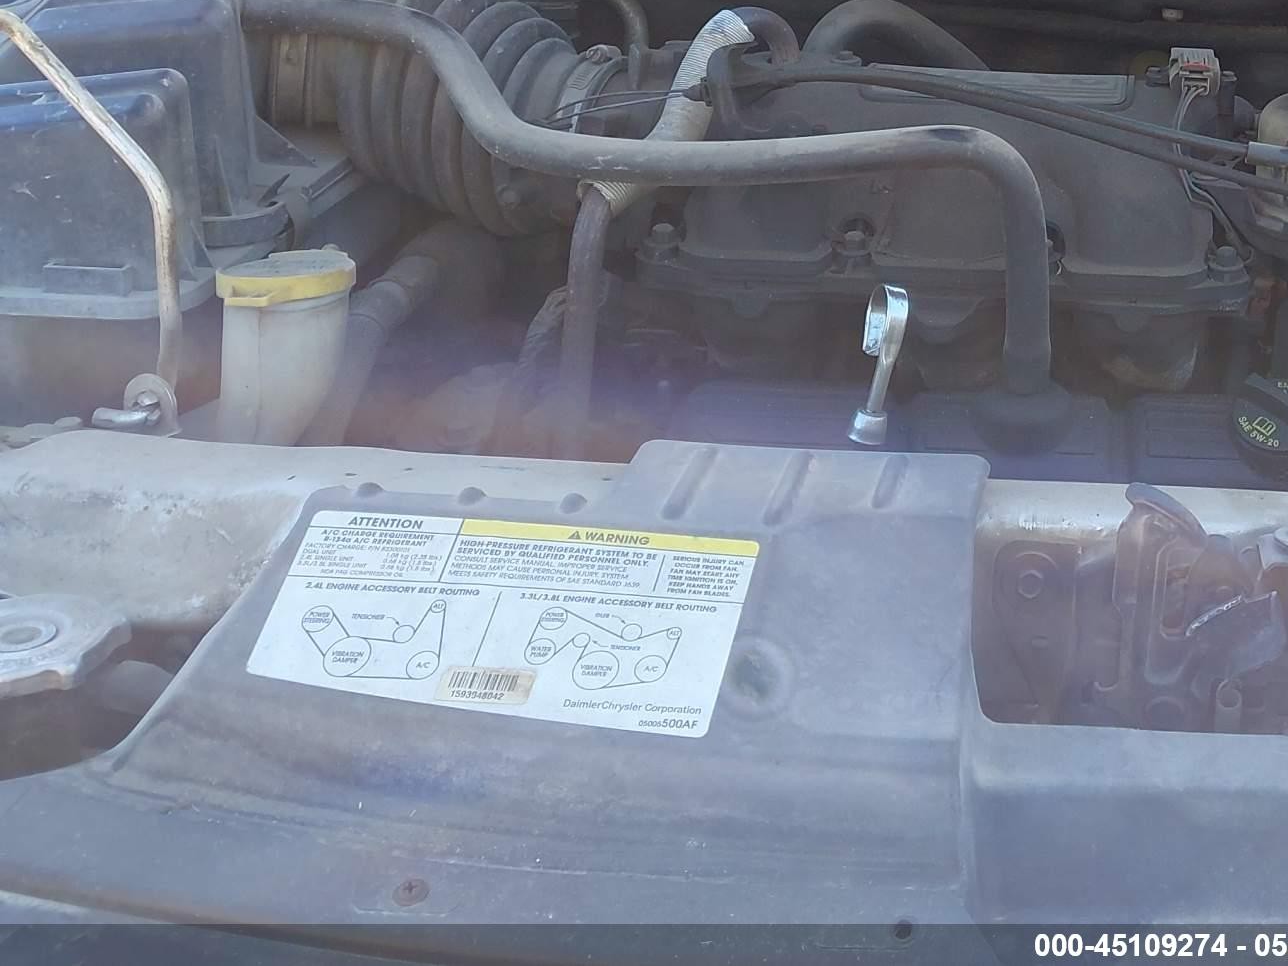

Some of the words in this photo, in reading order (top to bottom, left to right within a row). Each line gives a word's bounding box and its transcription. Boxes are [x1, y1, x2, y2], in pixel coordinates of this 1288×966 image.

[1238, 416, 1253, 433] SAE
[348, 516, 423, 530] ATTENTION
[342, 530, 378, 538] CHARGE
[379, 531, 435, 541] REQUIREMENT
[371, 538, 428, 547] REFRIGERANT
[584, 531, 650, 545] WARNING
[456, 546, 502, 556] SERVICED
[504, 549, 517, 557] BY
[518, 550, 566, 561] QUALIFIED
[567, 553, 621, 565] PERSONNEL
[532, 544, 594, 555] REFRIGERANT
[595, 549, 630, 558] SYSTEM
[646, 553, 658, 561] BE
[450, 561, 486, 570] METHODS
[506, 565, 532, 573] CAUSE
[532, 567, 571, 576] PERSONAL
[454, 554, 489, 563] CONSULT
[489, 557, 520, 565] SERVICE
[556, 561, 596, 570] IMPROPER
[596, 564, 628, 572] SERVICE
[499, 572, 555, 582] REQUIREMENTS
[582, 578, 622, 587] STANDARD
[684, 575, 716, 583] IGNITION
[305, 581, 324, 590] 2.4L
[325, 582, 359, 592] ENGINE
[360, 584, 417, 594] ACCESSORY
[418, 586, 437, 595] BELT
[439, 587, 481, 596] ROUTING
[519, 592, 561, 603] 3.3L/3.8L
[562, 595, 596, 604] ENGINE
[597, 597, 652, 608] ACCESSORY
[654, 601, 674, 610] BELT
[675, 603, 718, 613] ROUTING
[415, 661, 431, 670] A/C
[563, 698, 643, 714] DaimlerChrysler
[645, 702, 702, 716] Corporation
